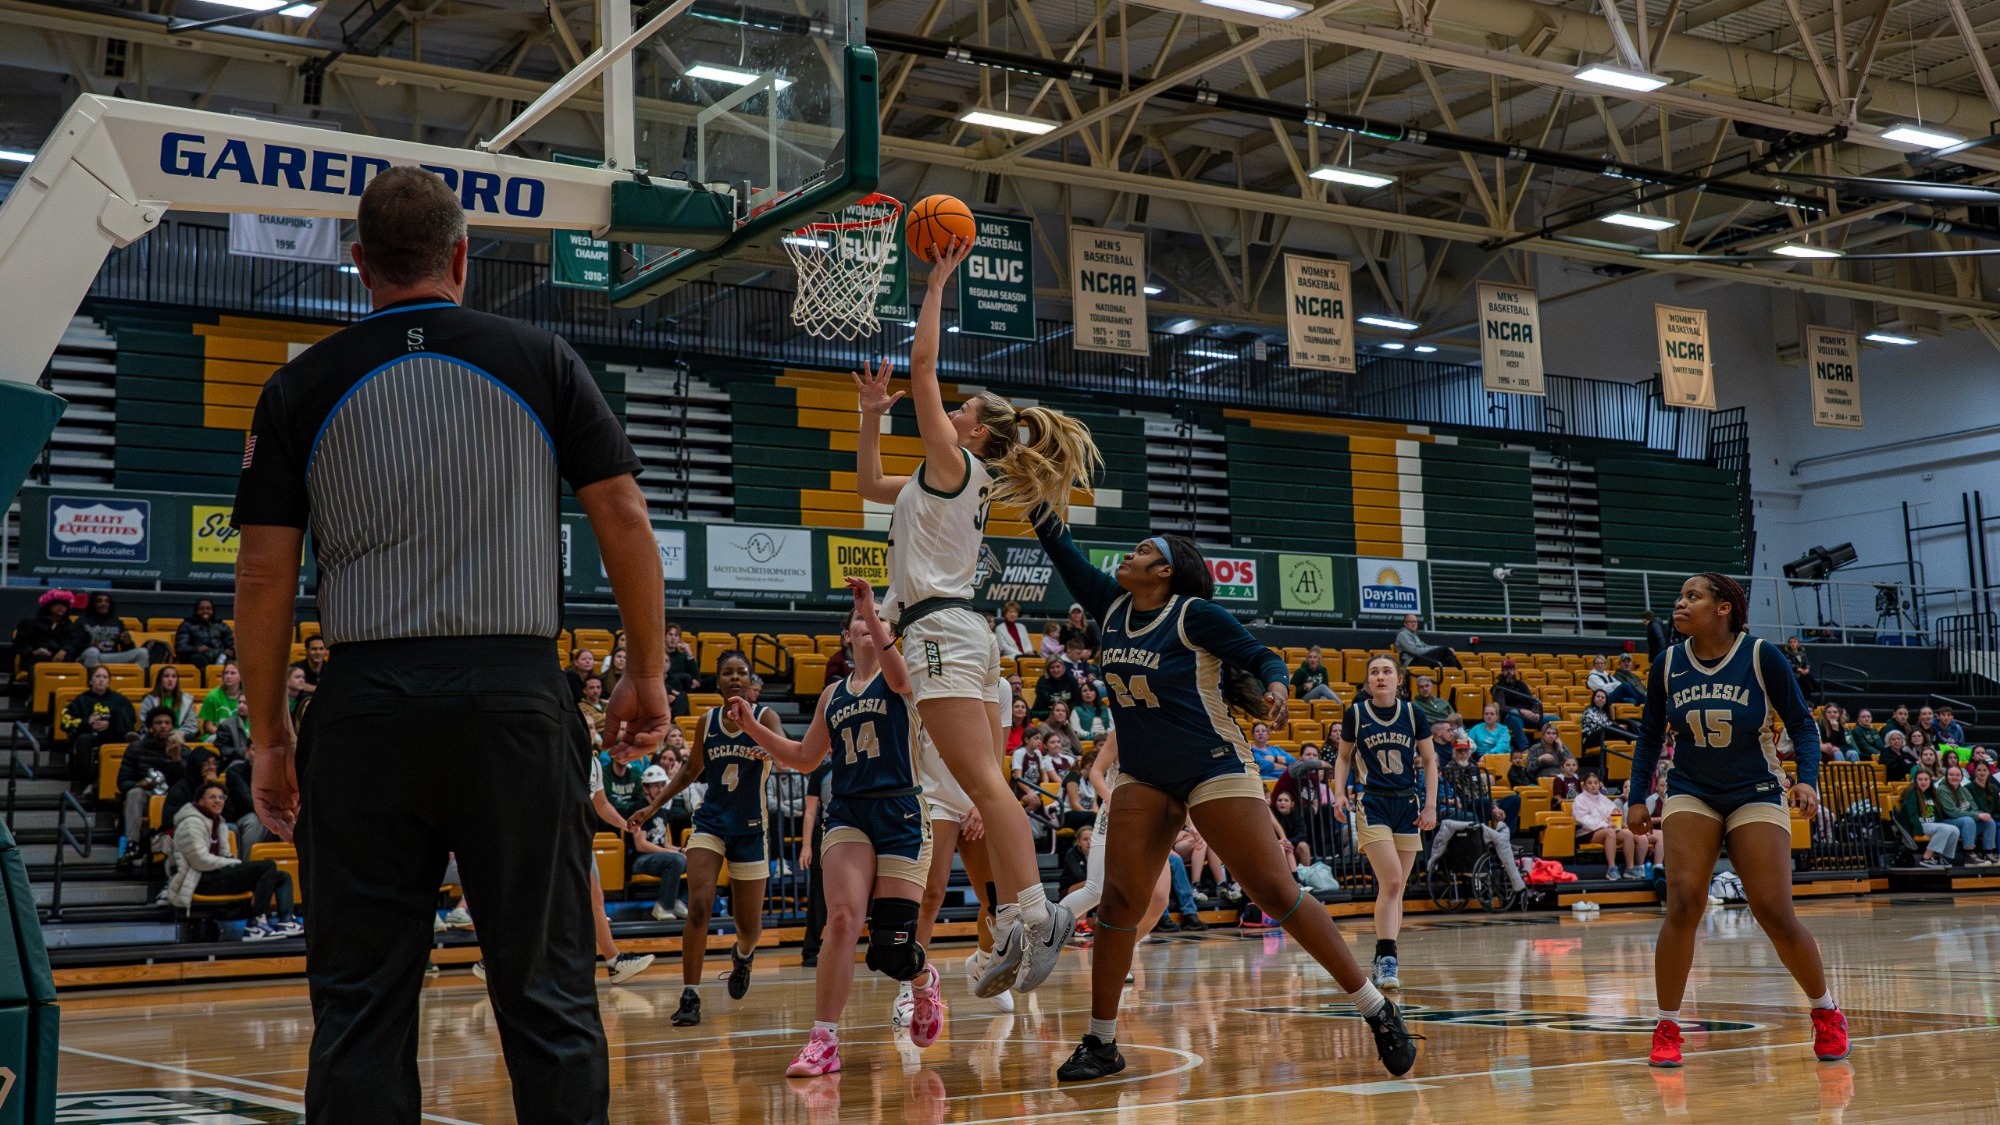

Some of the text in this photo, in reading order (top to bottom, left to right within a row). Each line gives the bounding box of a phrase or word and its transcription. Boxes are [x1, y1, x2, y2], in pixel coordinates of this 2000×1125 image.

[160, 132, 391, 197] GARED
[981, 222, 1009, 236] MEN'S
[570, 234, 592, 247] WEST
[974, 236, 1023, 252] ASKETBALL
[1094, 239, 1121, 251] MEN'S
[840, 237, 898, 265] GLVC
[1083, 251, 1134, 266] BASKETBALL
[968, 255, 1024, 283] GLVC
[1300, 265, 1336, 279] WOMEN'S
[1081, 269, 1137, 297] NCAA
[1297, 277, 1341, 291] BASKETBALL
[969, 287, 1027, 302] REGULAR SEASON
[1496, 291, 1519, 303] MEN'S
[977, 300, 1018, 313] CHAMPIONS
[1095, 303, 1126, 314] NATIONAL
[1294, 294, 1345, 320] NCAA
[1488, 302, 1530, 316] BASKETBALL
[1668, 313, 1698, 325] WOMEN'S
[1486, 319, 1533, 343] NCAA
[1665, 339, 1705, 362] NCAA
[1816, 361, 1854, 382] NCAA
[73, 514, 124, 525] REALTY
[58, 522, 138, 536] EXECUTIVES
[90, 545, 136, 556] Associates
[837, 545, 888, 566] DICKEY
[1006, 547, 1041, 565] THIS
[843, 566, 882, 578] BARBECUE
[1001, 565, 1053, 584] MINER
[986, 583, 1047, 602] NATION
[1363, 587, 1414, 602] Days Inn
[1101, 647, 1160, 670] ECCLESIA
[1105, 672, 1160, 708] 24
[1672, 683, 1750, 709] ECCLESIA
[830, 698, 887, 729] ECCLESIA
[1685, 709, 1733, 748] 15
[841, 720, 880, 765] 14
[1363, 731, 1411, 749] ECCLESIA
[1376, 749, 1404, 775] 10
[721, 763, 739, 792] 4
